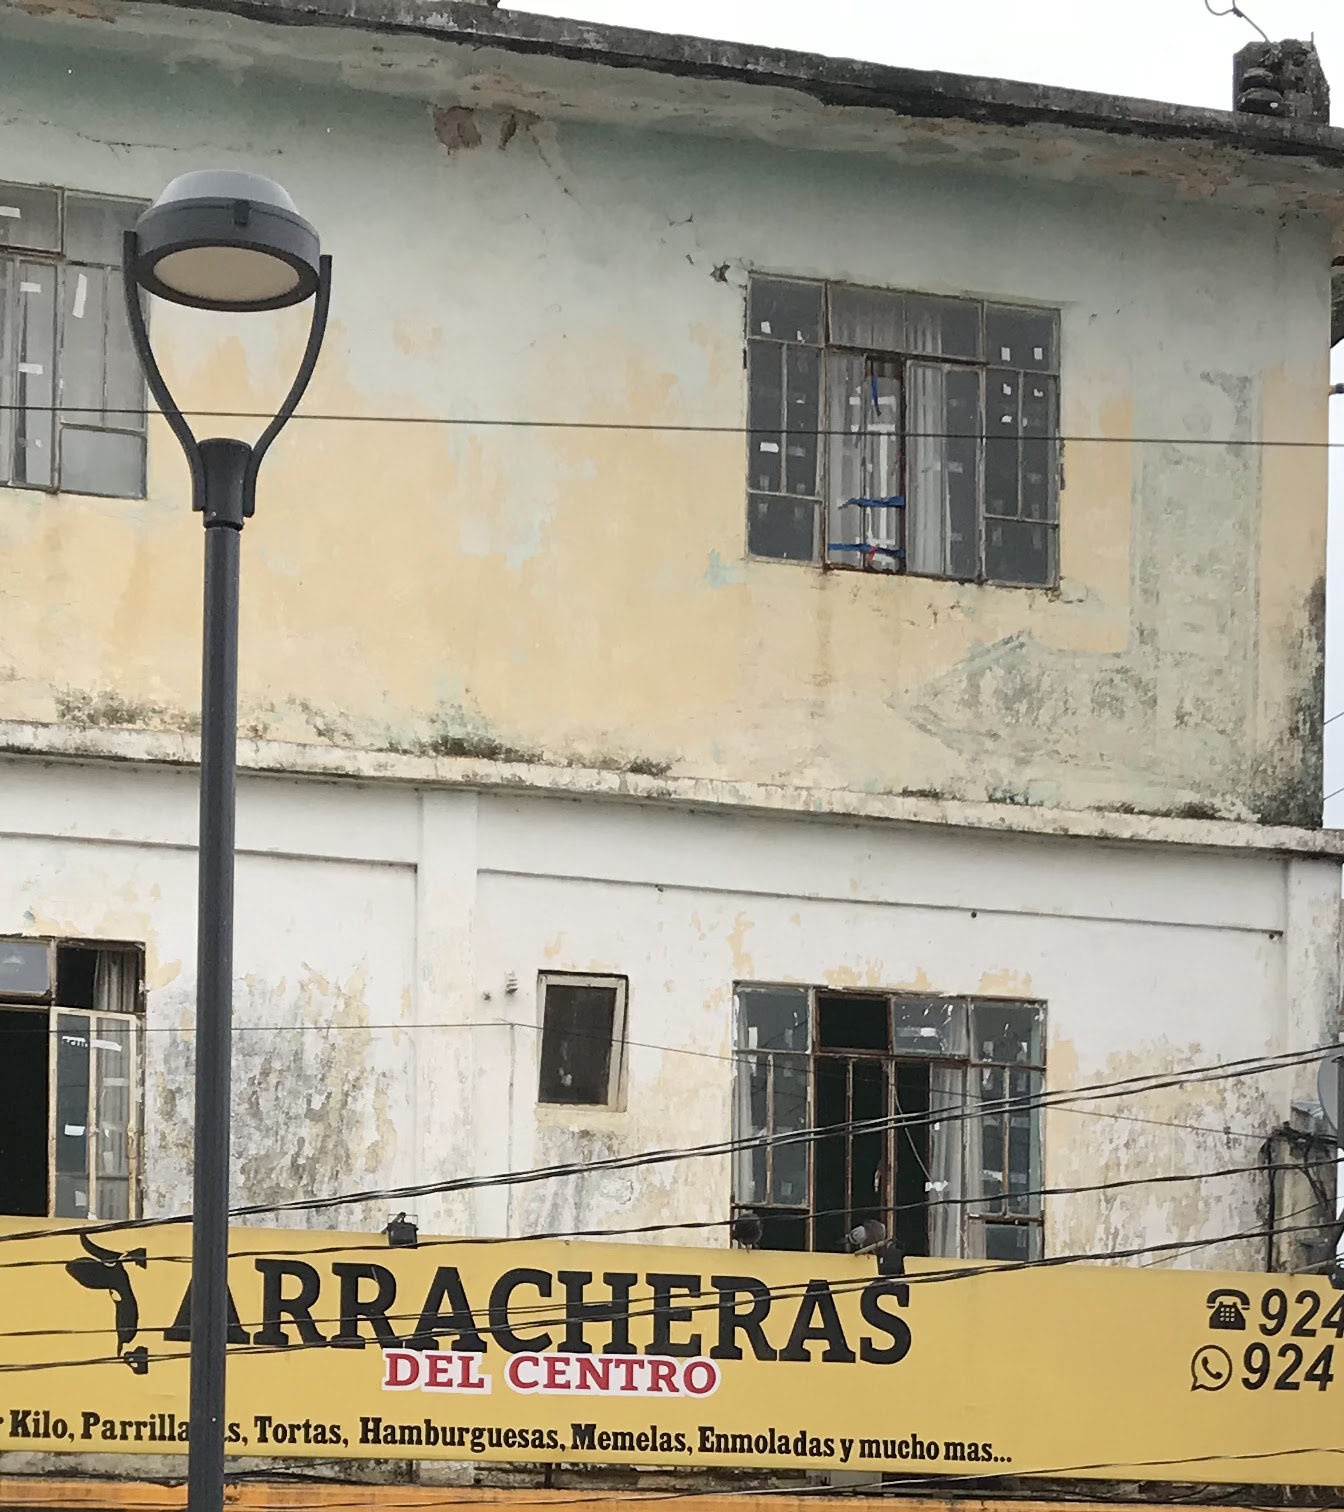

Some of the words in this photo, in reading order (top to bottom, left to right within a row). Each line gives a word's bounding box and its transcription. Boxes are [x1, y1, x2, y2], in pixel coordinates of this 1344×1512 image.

[163, 1257, 912, 1365] ARRACHERAS
[384, 1352, 486, 1390] DEL
[508, 1355, 718, 1395] CENTRO
[1241, 1342, 1335, 1391] 924
[8, 1409, 76, 1443] Kilo,
[80, 1411, 249, 1446] Parrillas,
[253, 1415, 350, 1449] Tortas,
[359, 1416, 566, 1453] Hamburguesas,
[570, 1423, 693, 1456] Memelas,
[697, 1426, 835, 1458] Enmoladas
[839, 1437, 853, 1463] y
[859, 1433, 939, 1460] mucho
[943, 1440, 1013, 1463] mas...
